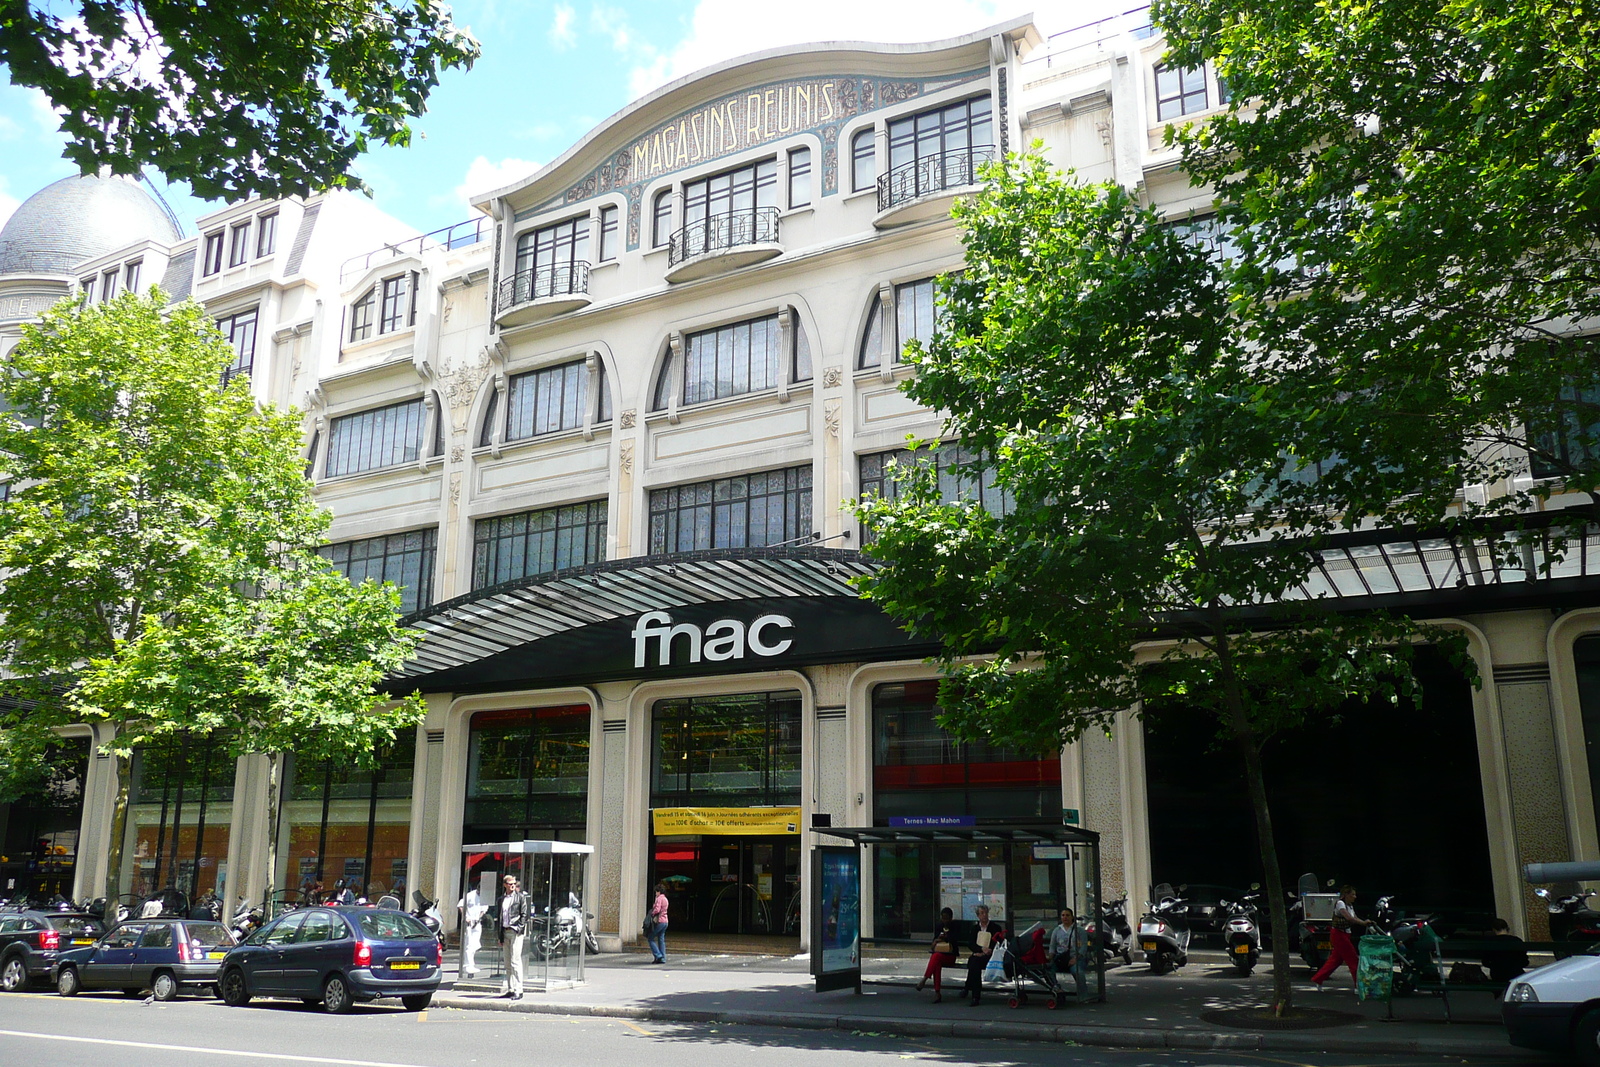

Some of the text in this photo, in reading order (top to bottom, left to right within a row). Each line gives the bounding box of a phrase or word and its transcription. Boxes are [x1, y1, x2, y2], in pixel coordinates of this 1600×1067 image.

[633, 83, 834, 180] MAGASINS REUNIS
[631, 610, 794, 668] fnac
